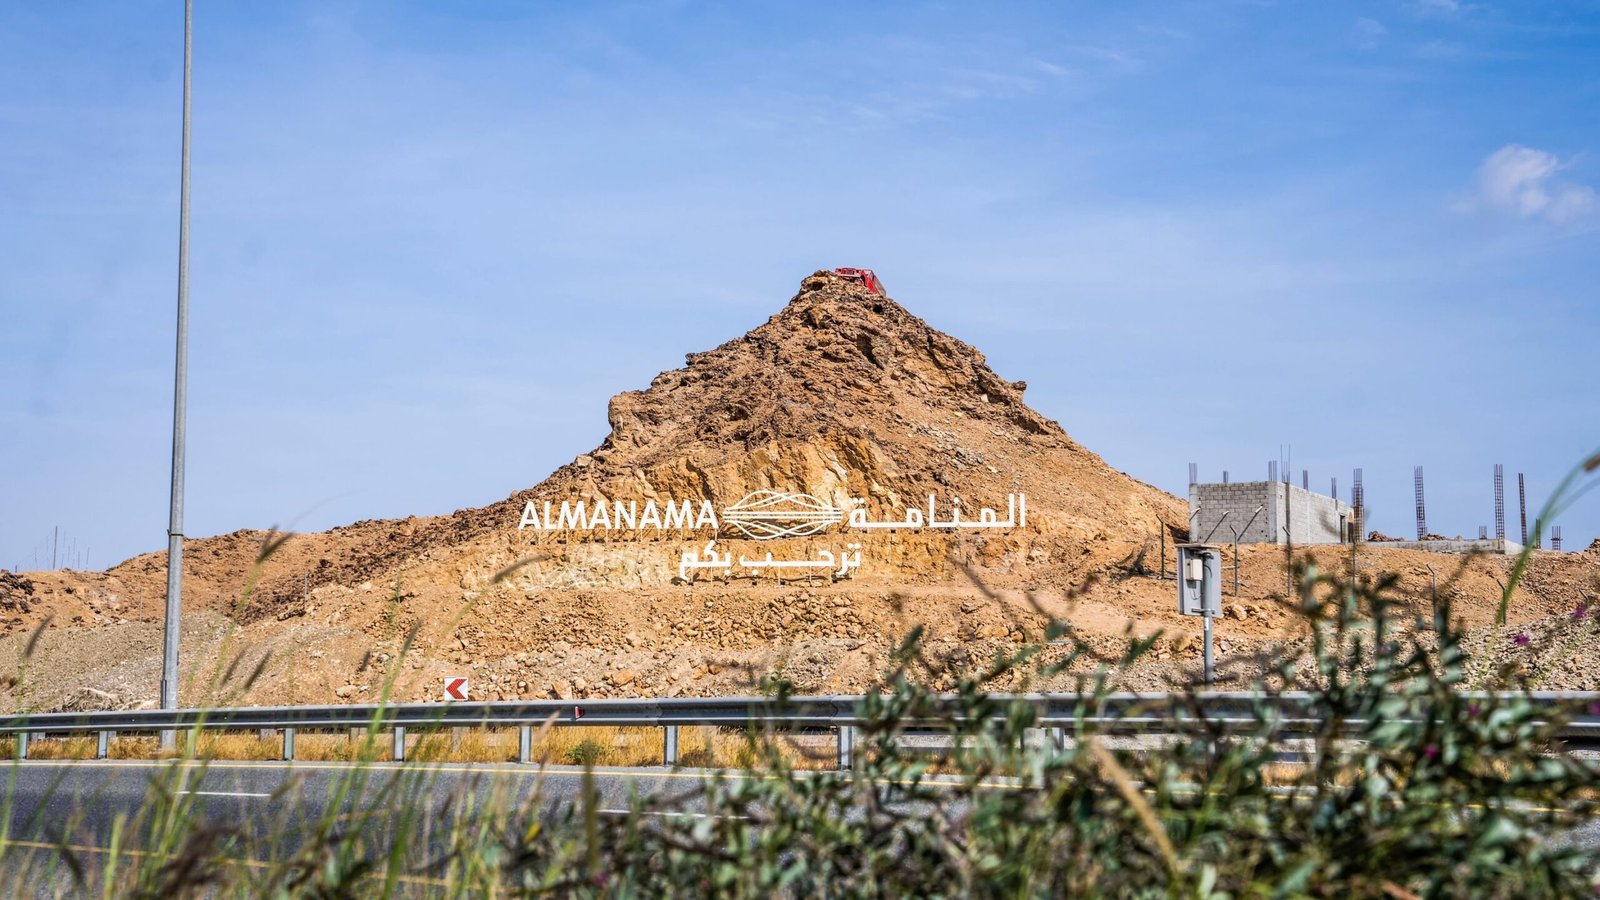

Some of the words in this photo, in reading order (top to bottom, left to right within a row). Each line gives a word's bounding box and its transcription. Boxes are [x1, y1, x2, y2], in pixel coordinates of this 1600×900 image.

[518, 500, 719, 530] ALMANAMA
[849, 493, 1026, 528] المنامة
[679, 540, 731, 581] بكم
[739, 543, 862, 576] ترحب
